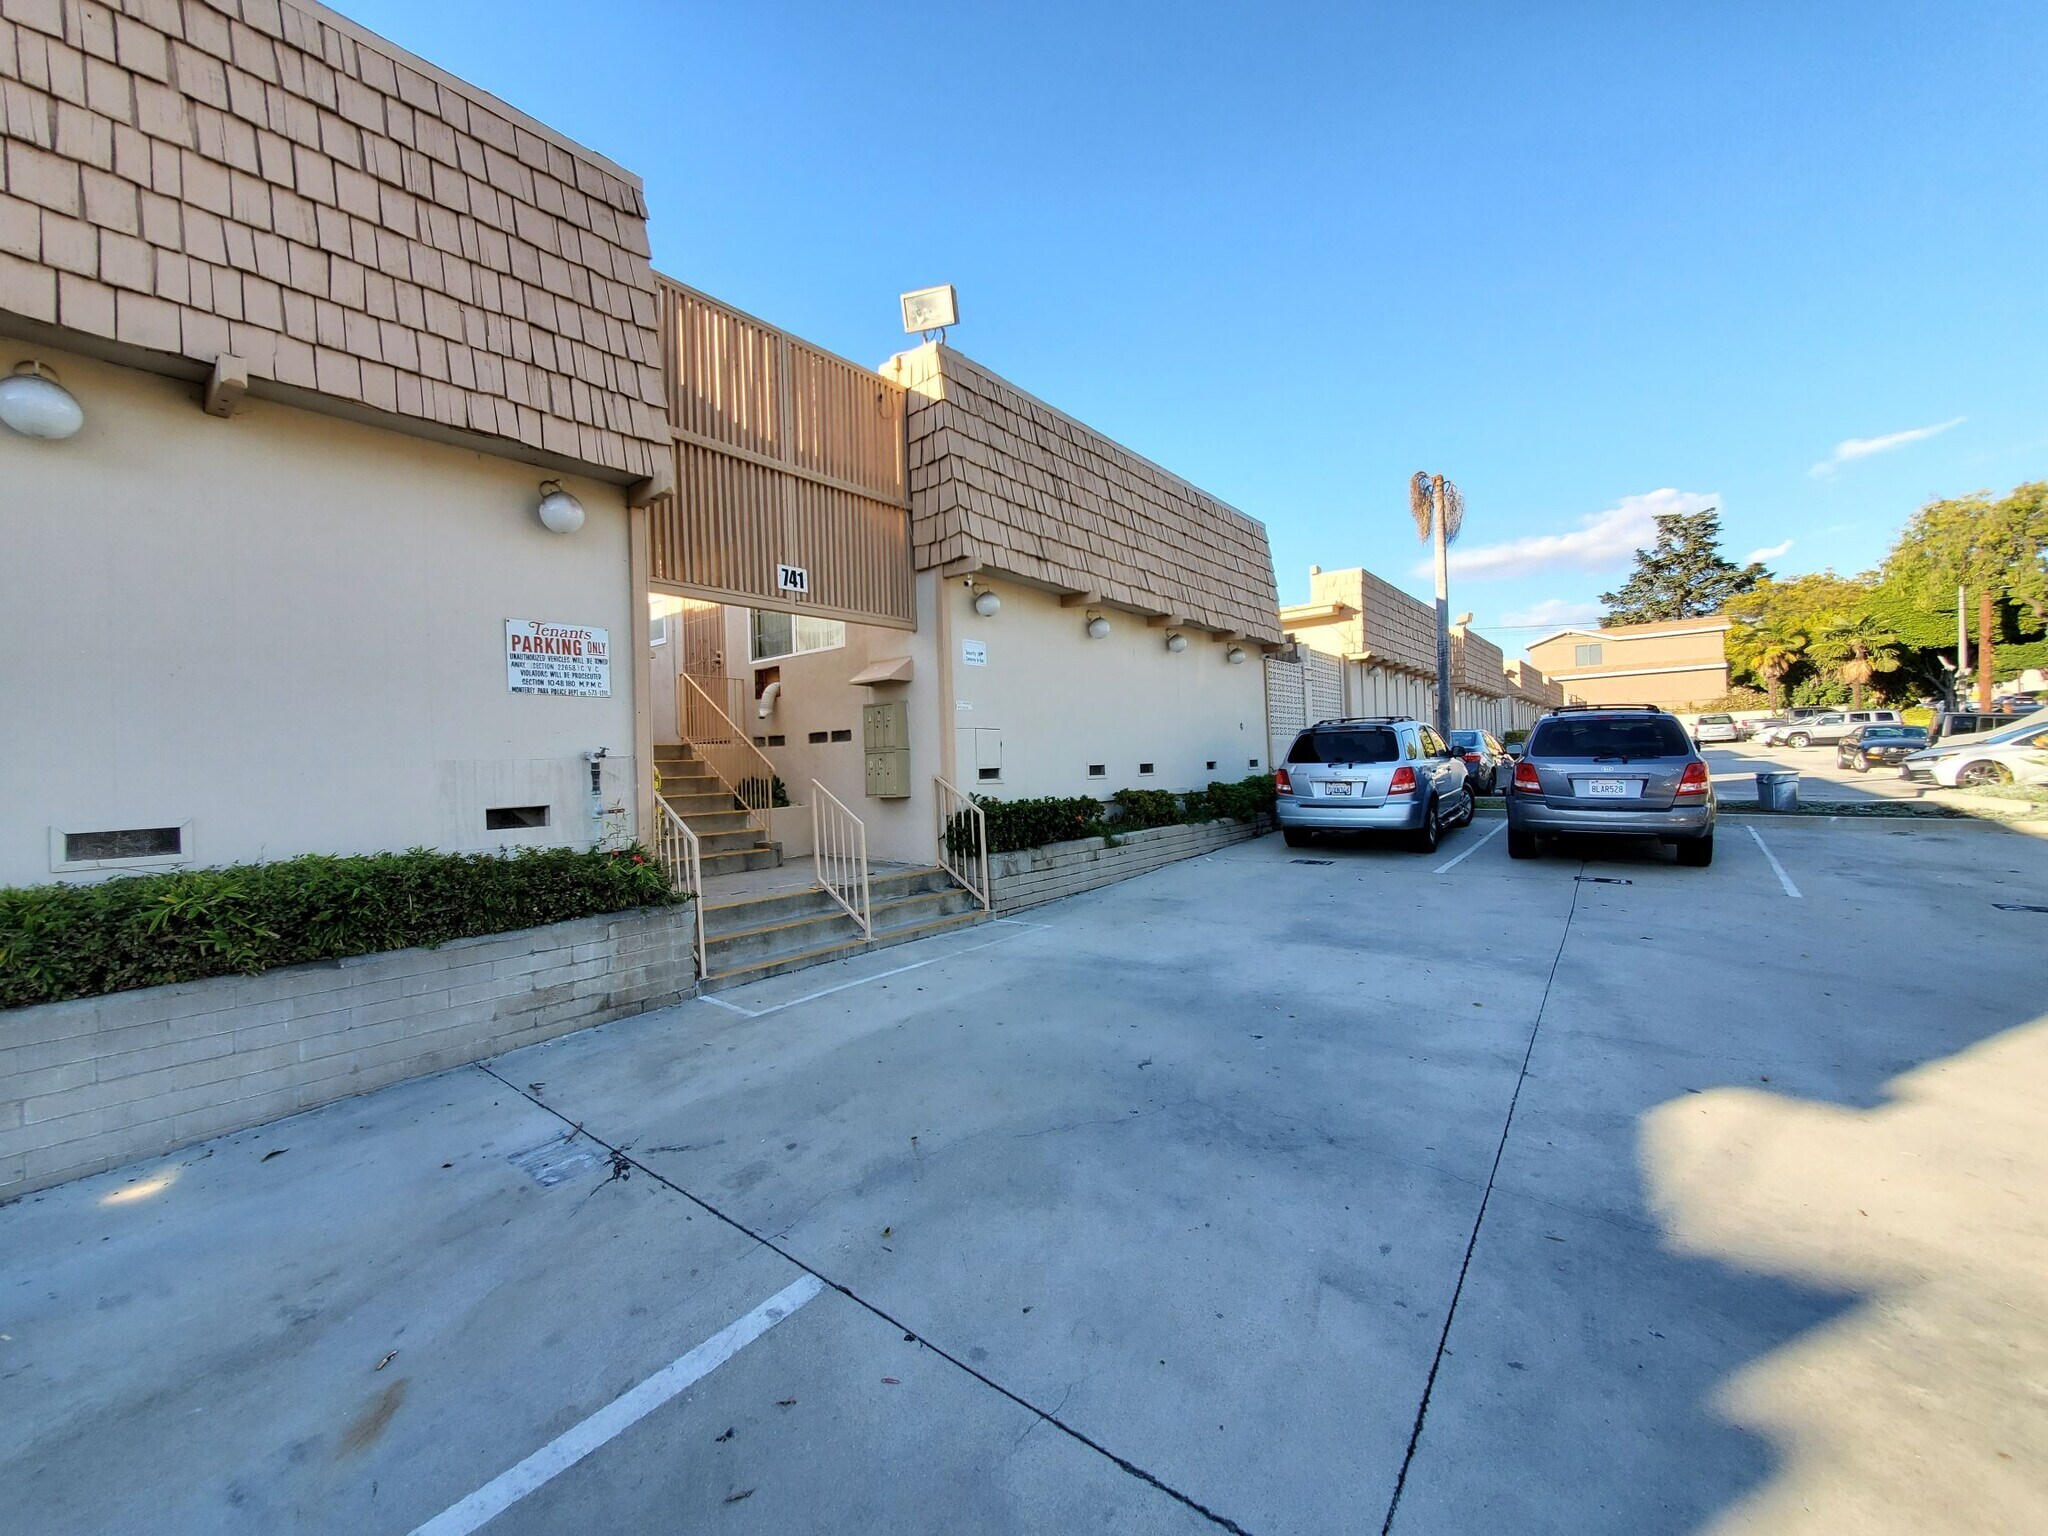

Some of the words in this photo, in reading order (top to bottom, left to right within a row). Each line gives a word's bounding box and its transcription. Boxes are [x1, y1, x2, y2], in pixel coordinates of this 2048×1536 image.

[782, 568, 804, 588] 741
[528, 622, 592, 640] Tenants
[512, 635, 582, 656] PARKING
[587, 641, 606, 654] ONLY
[510, 653, 546, 662] UNAUTHORIZED
[520, 670, 548, 678] VIOLATORS
